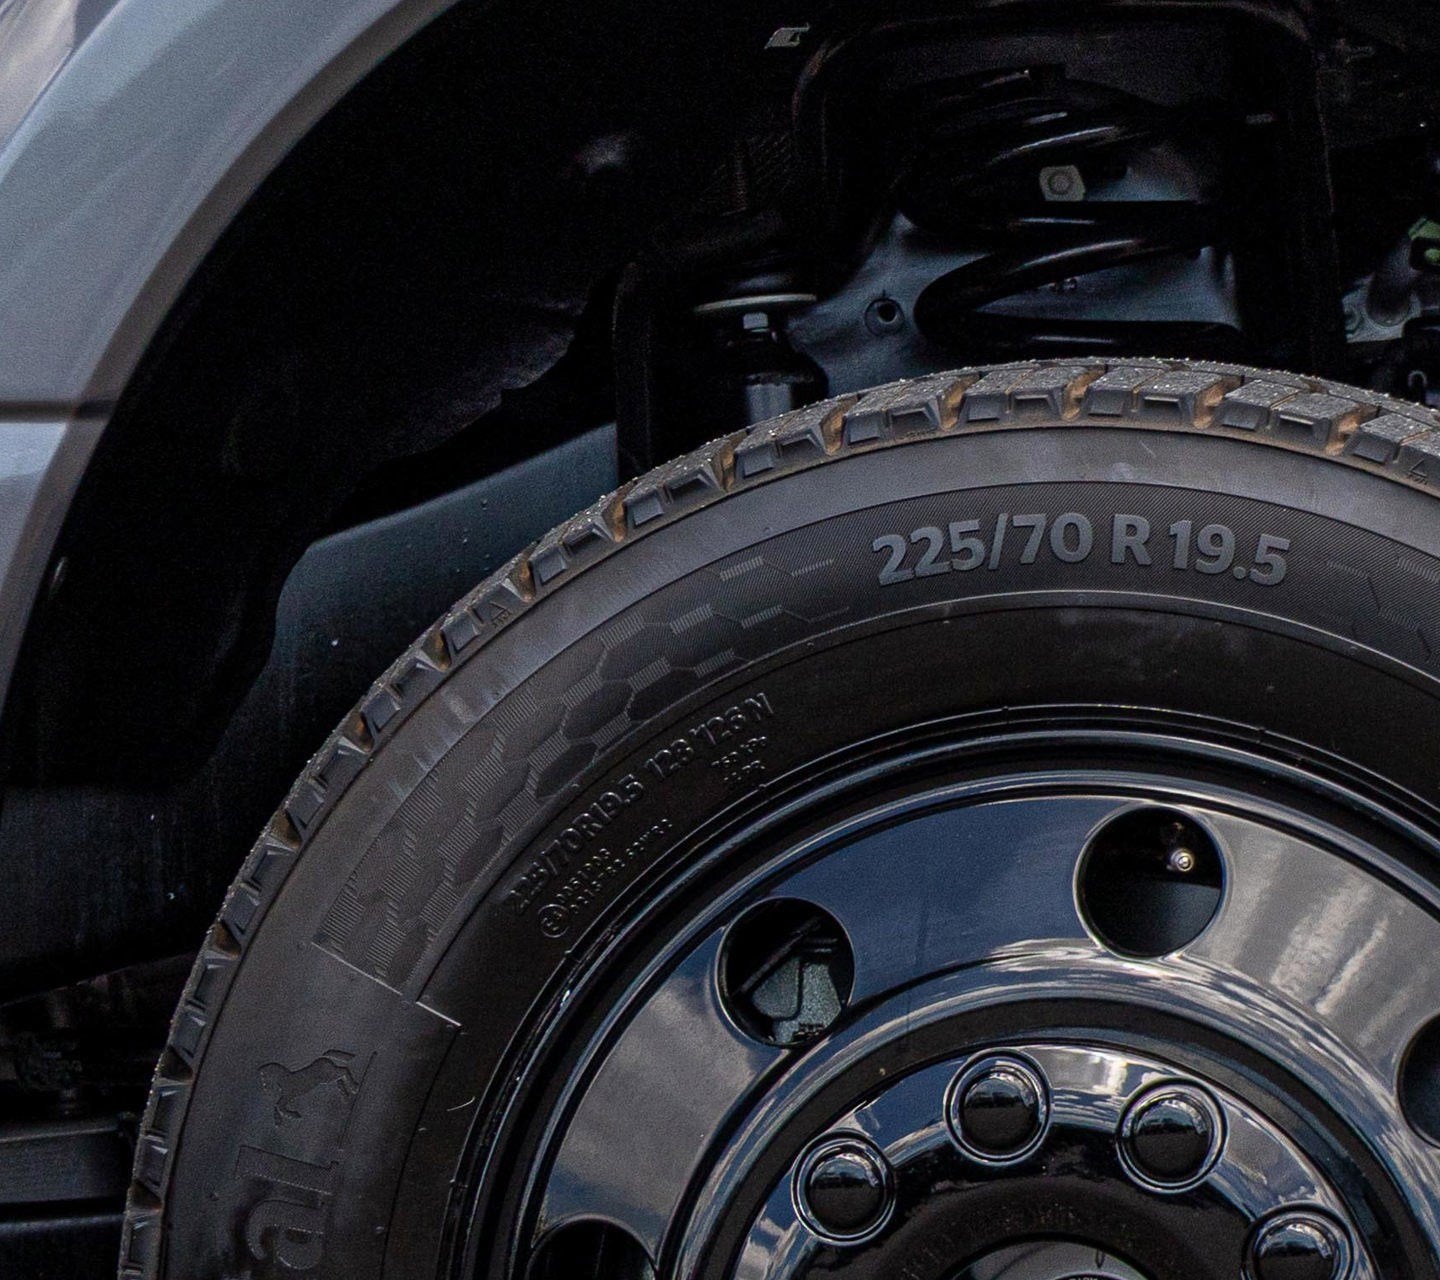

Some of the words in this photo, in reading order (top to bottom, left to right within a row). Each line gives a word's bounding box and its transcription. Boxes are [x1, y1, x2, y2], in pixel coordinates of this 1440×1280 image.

[872, 512, 1094, 587] 225/70
[1111, 513, 1154, 566] R
[1168, 519, 1291, 587] 19.5
